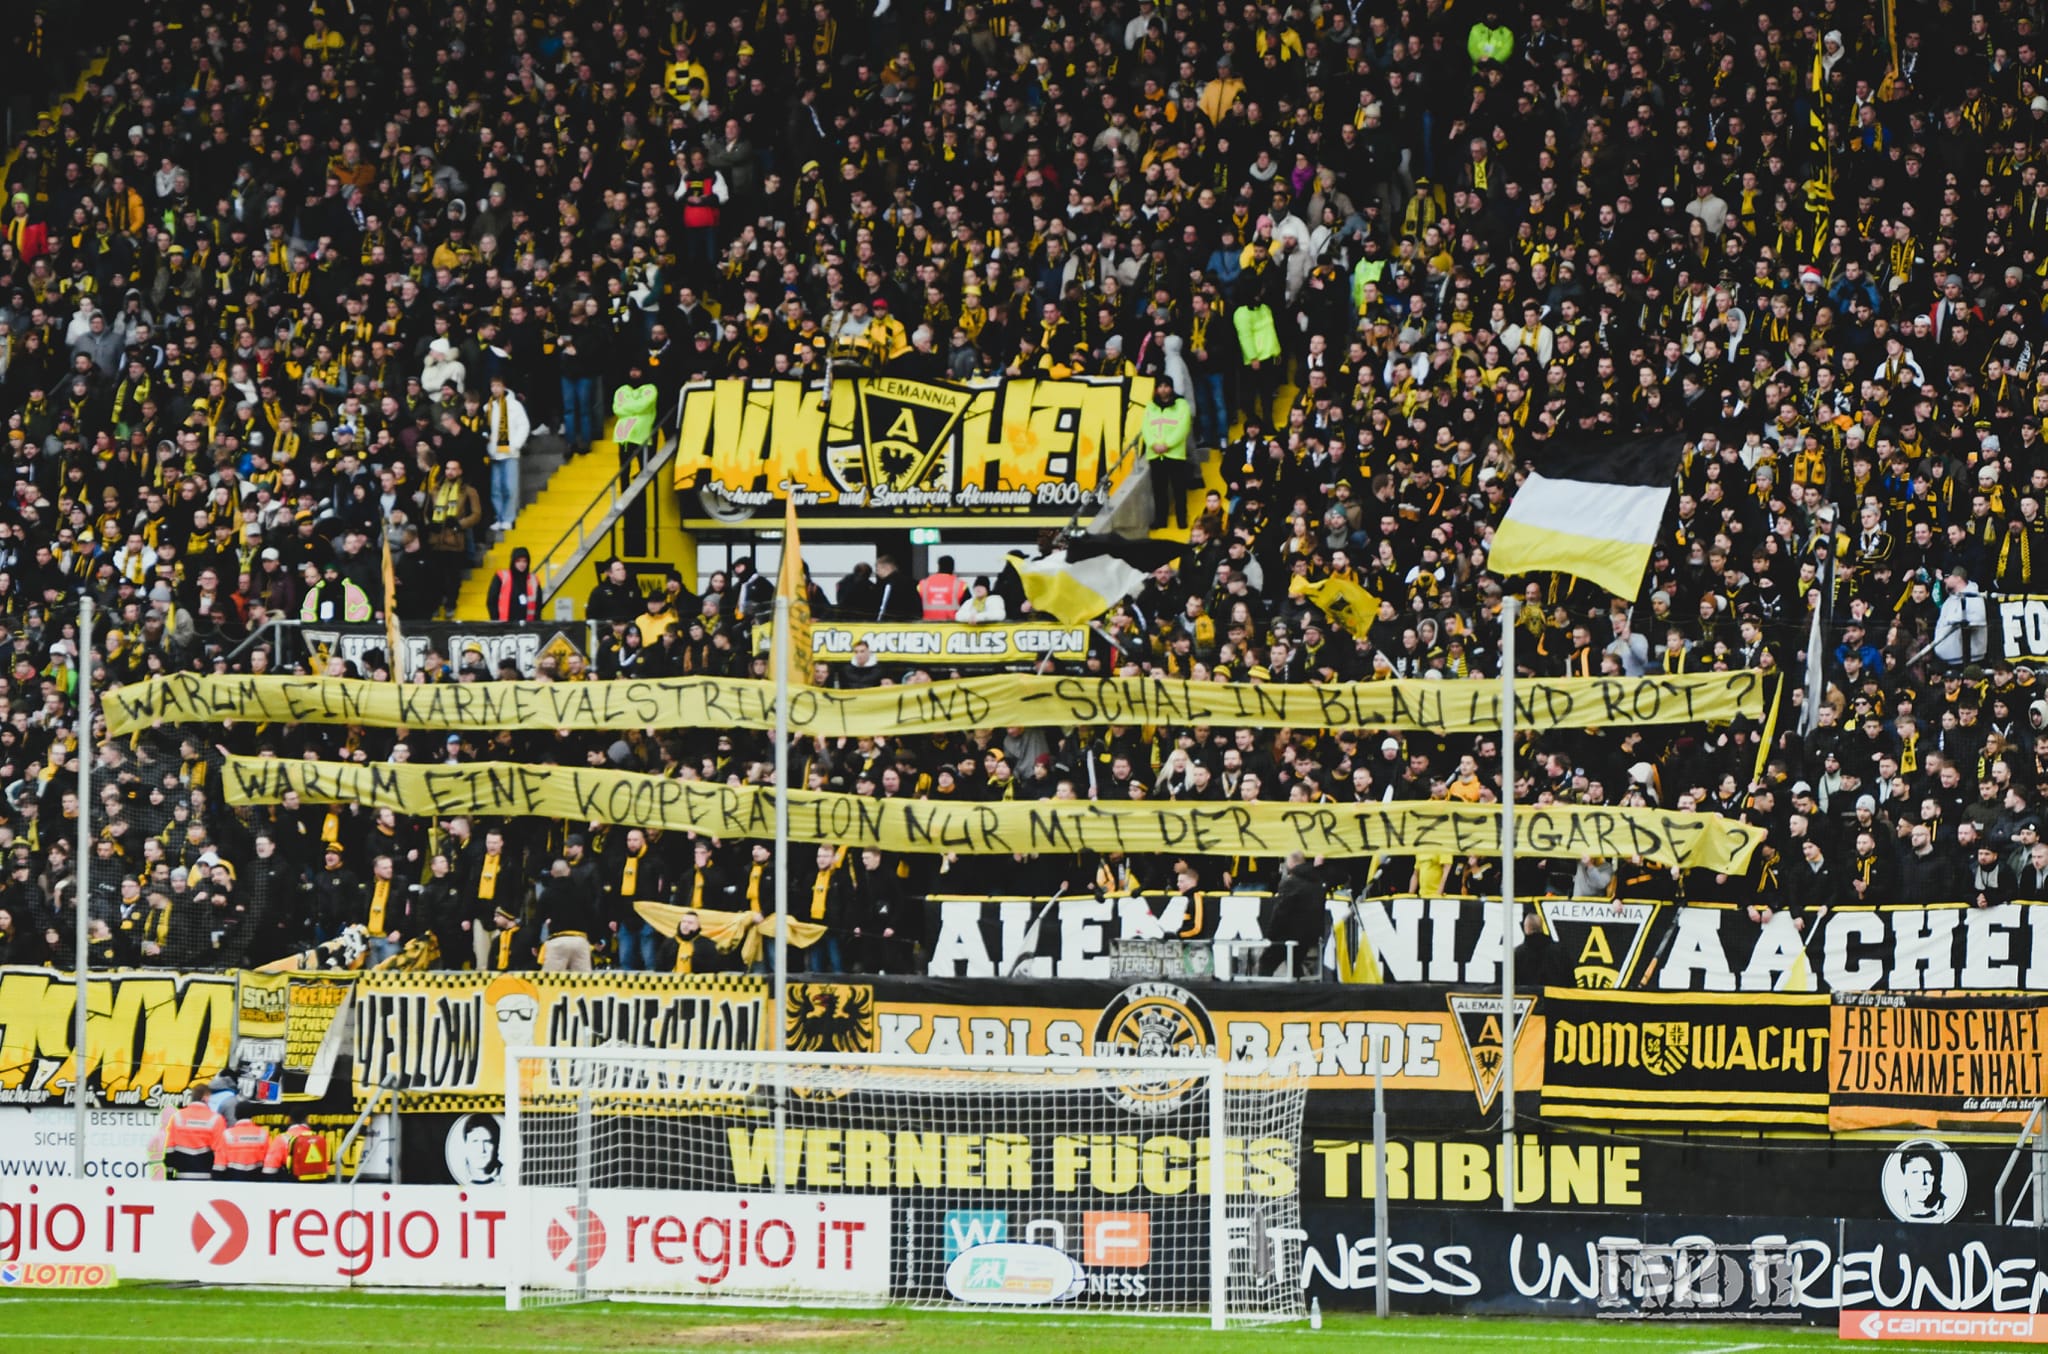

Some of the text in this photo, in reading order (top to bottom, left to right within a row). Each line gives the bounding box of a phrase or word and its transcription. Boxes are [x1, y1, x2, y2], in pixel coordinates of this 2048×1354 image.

[864, 377, 957, 408] ALEMANNIA
[886, 407, 919, 443] A
[838, 488, 867, 506] und
[955, 484, 1032, 506] Alemannia
[1036, 482, 1079, 505] 1900
[812, 628, 853, 654] FÜR
[946, 631, 1007, 654] ALLES
[1014, 630, 1084, 653] GEBEN!
[117, 672, 270, 720] WARUM
[282, 682, 366, 720] EIN
[398, 680, 857, 733] KARNEVALSTRIKOT
[896, 685, 991, 725] UND
[1233, 684, 1288, 721] IN
[1316, 684, 1446, 732] BLAU
[1469, 683, 1574, 728] UND
[1593, 678, 1708, 722] ROT
[1726, 672, 1757, 708] ?
[232, 760, 1751, 864] WARUM EINE KOOPERATION NUR MIT DER PRINZENGARDE ?
[927, 896, 1526, 984] ALEMANIA
[1578, 925, 1615, 964] A
[1123, 982, 1190, 1004] KARLS
[1457, 1001, 1524, 1010] ALEMANIA
[1858, 993, 1875, 1006] die
[355, 993, 761, 1091] YELLOW CONNECTION
[877, 1012, 1443, 1077] KARLS BANDE
[1478, 1014, 1504, 1043] A
[1553, 1019, 1641, 1068] DOM
[1691, 1023, 1830, 1073] WACHT
[1843, 1007, 2039, 1052] FREUNDSCHAFT
[1836, 1049, 2042, 1095] ZUSAMMENHALT
[115, 1087, 141, 1104] und
[91, 1112, 158, 1127] BESTELLT
[34, 1132, 76, 1146] SICHE
[727, 1127, 1643, 1206] WERNER FUCHS TRIBÜNE
[268, 1190, 440, 1276] regio
[625, 1200, 797, 1285] regio
[23, 1263, 104, 1286] LOTTO
[1218, 1217, 1482, 1296] FTNESS
[1510, 1232, 1723, 1304] UNTER
[1887, 1316, 2034, 1337] camcontrol
